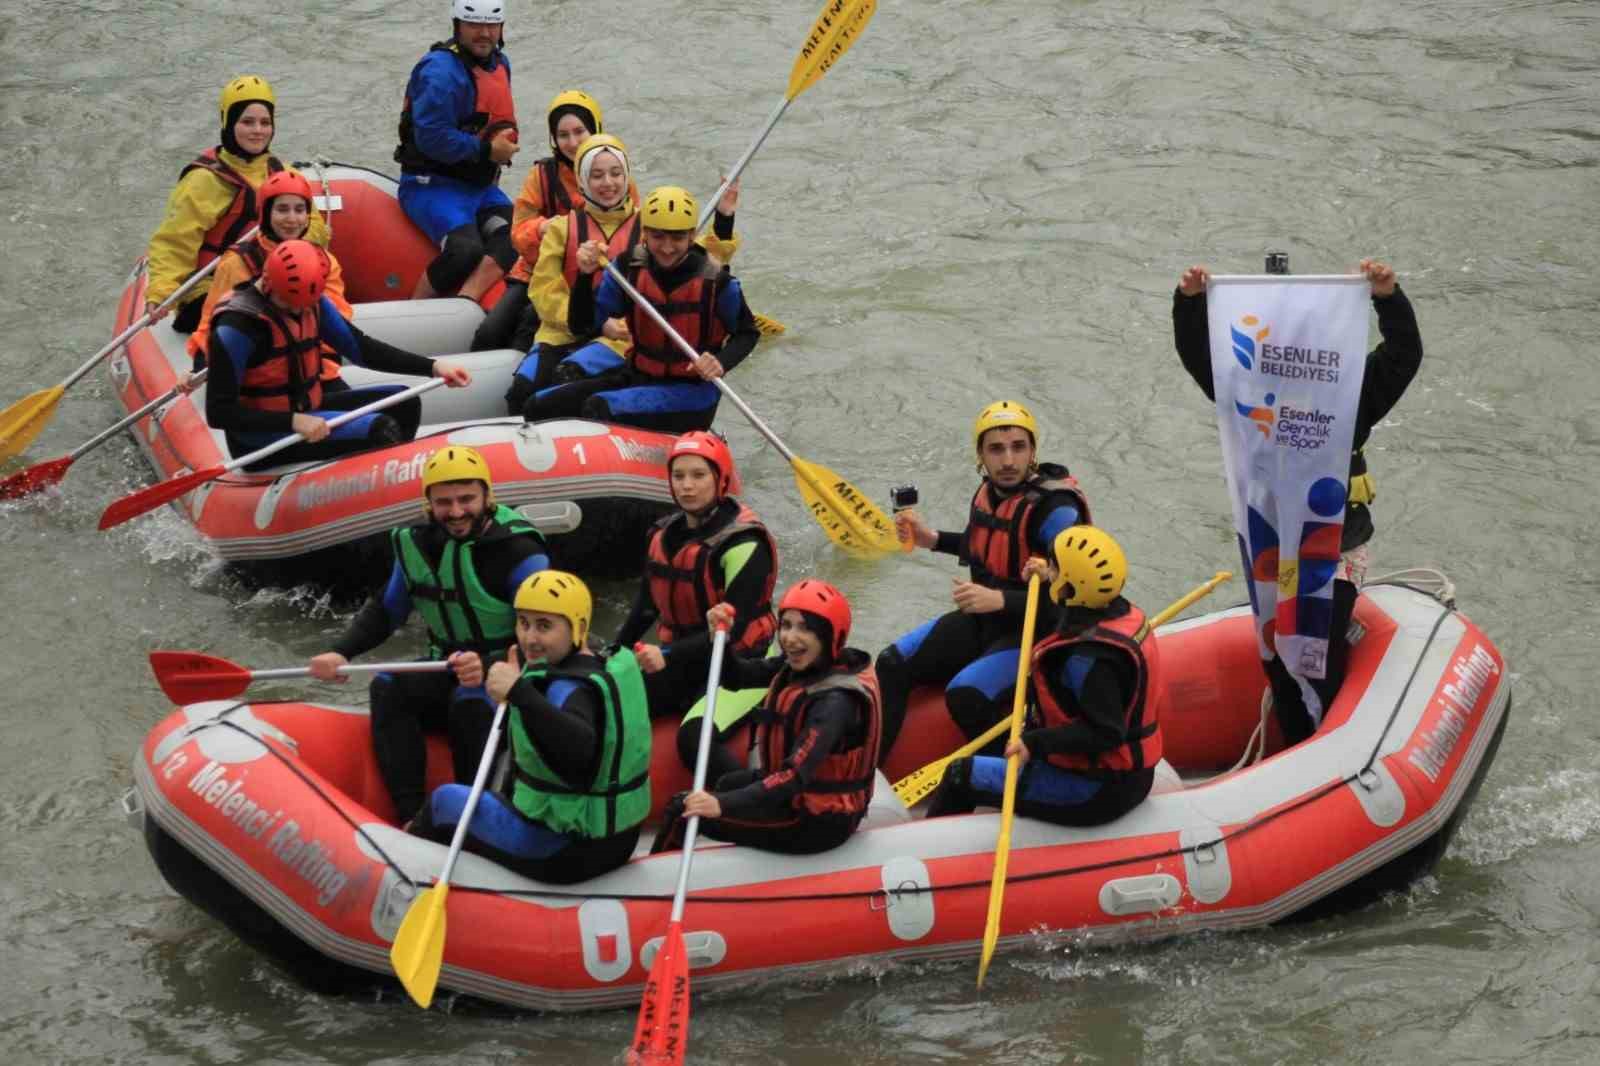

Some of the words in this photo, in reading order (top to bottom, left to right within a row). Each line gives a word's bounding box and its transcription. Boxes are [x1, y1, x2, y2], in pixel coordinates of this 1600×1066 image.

[1261, 344, 1341, 368] ESENLER
[1279, 406, 1336, 424] Esenler
[572, 442, 587, 465] 1
[1289, 434, 1326, 451] Spor
[1442, 643, 1500, 714] Rafting
[187, 759, 284, 841] Melenci
